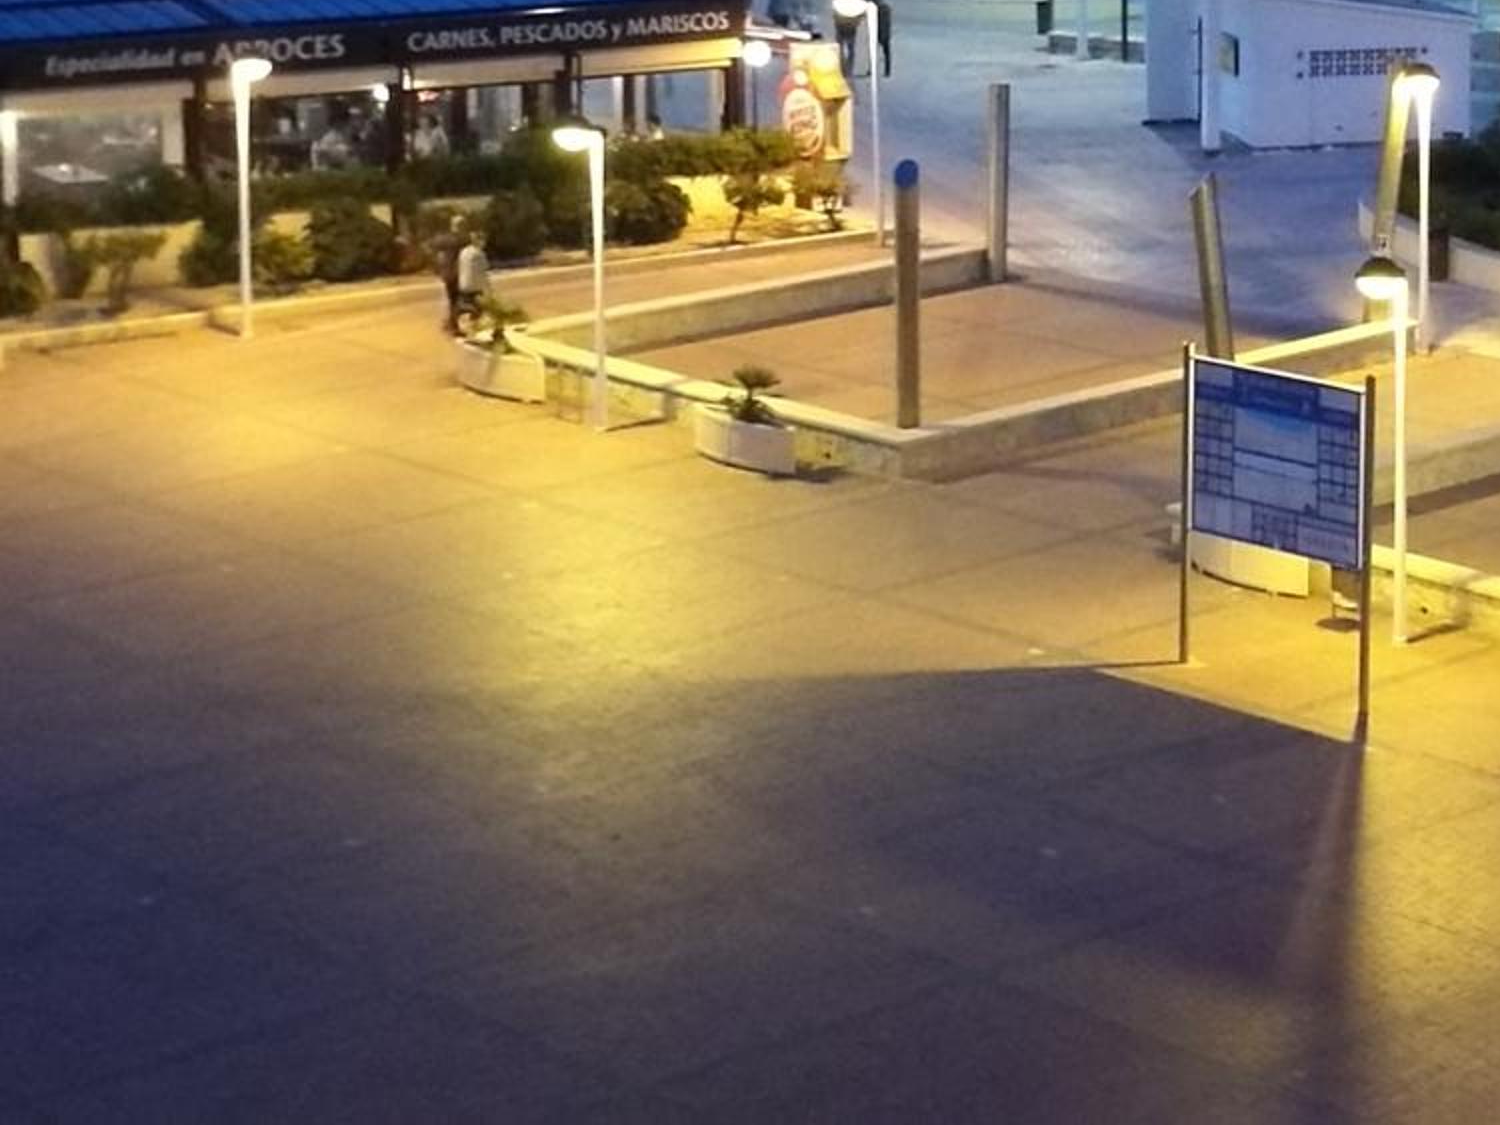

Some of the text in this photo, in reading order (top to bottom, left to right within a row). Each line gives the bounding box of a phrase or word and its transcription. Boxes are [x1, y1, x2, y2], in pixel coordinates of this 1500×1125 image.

[500, 20, 606, 45] PESCADOS
[610, 25, 623, 41] y
[626, 10, 729, 36] MARISCOS
[45, 47, 176, 78] Especialidad
[180, 50, 206, 67] en
